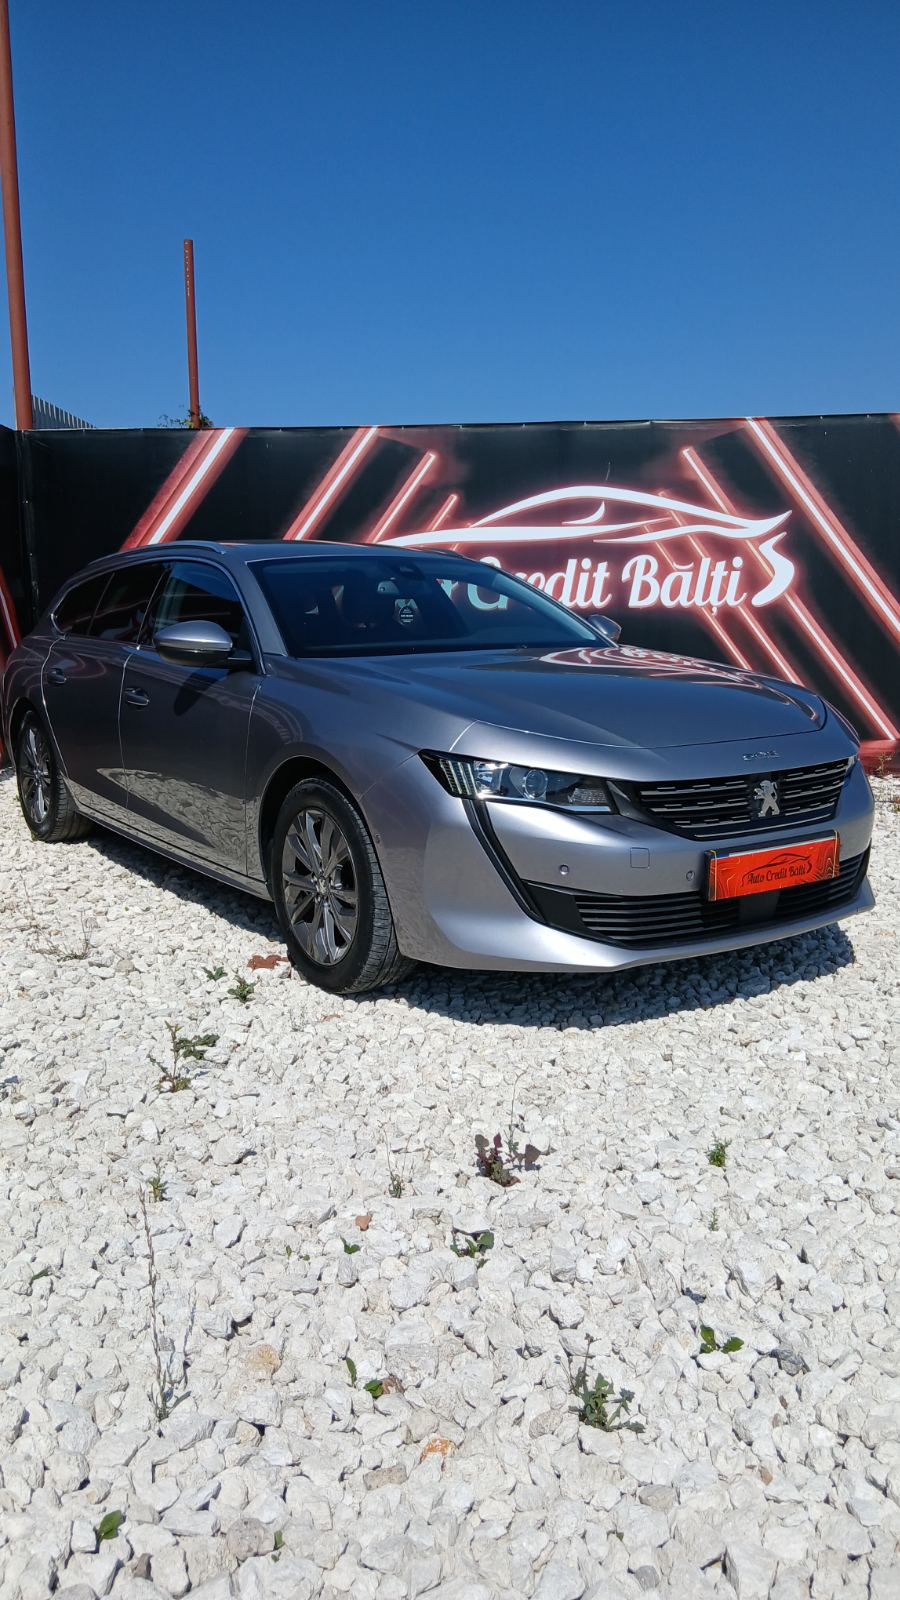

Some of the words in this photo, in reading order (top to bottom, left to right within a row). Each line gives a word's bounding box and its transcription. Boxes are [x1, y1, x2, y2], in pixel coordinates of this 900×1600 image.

[621, 554, 748, 615] Bălți
[747, 873, 765, 884] Auto
[766, 868, 787, 881] Credit
